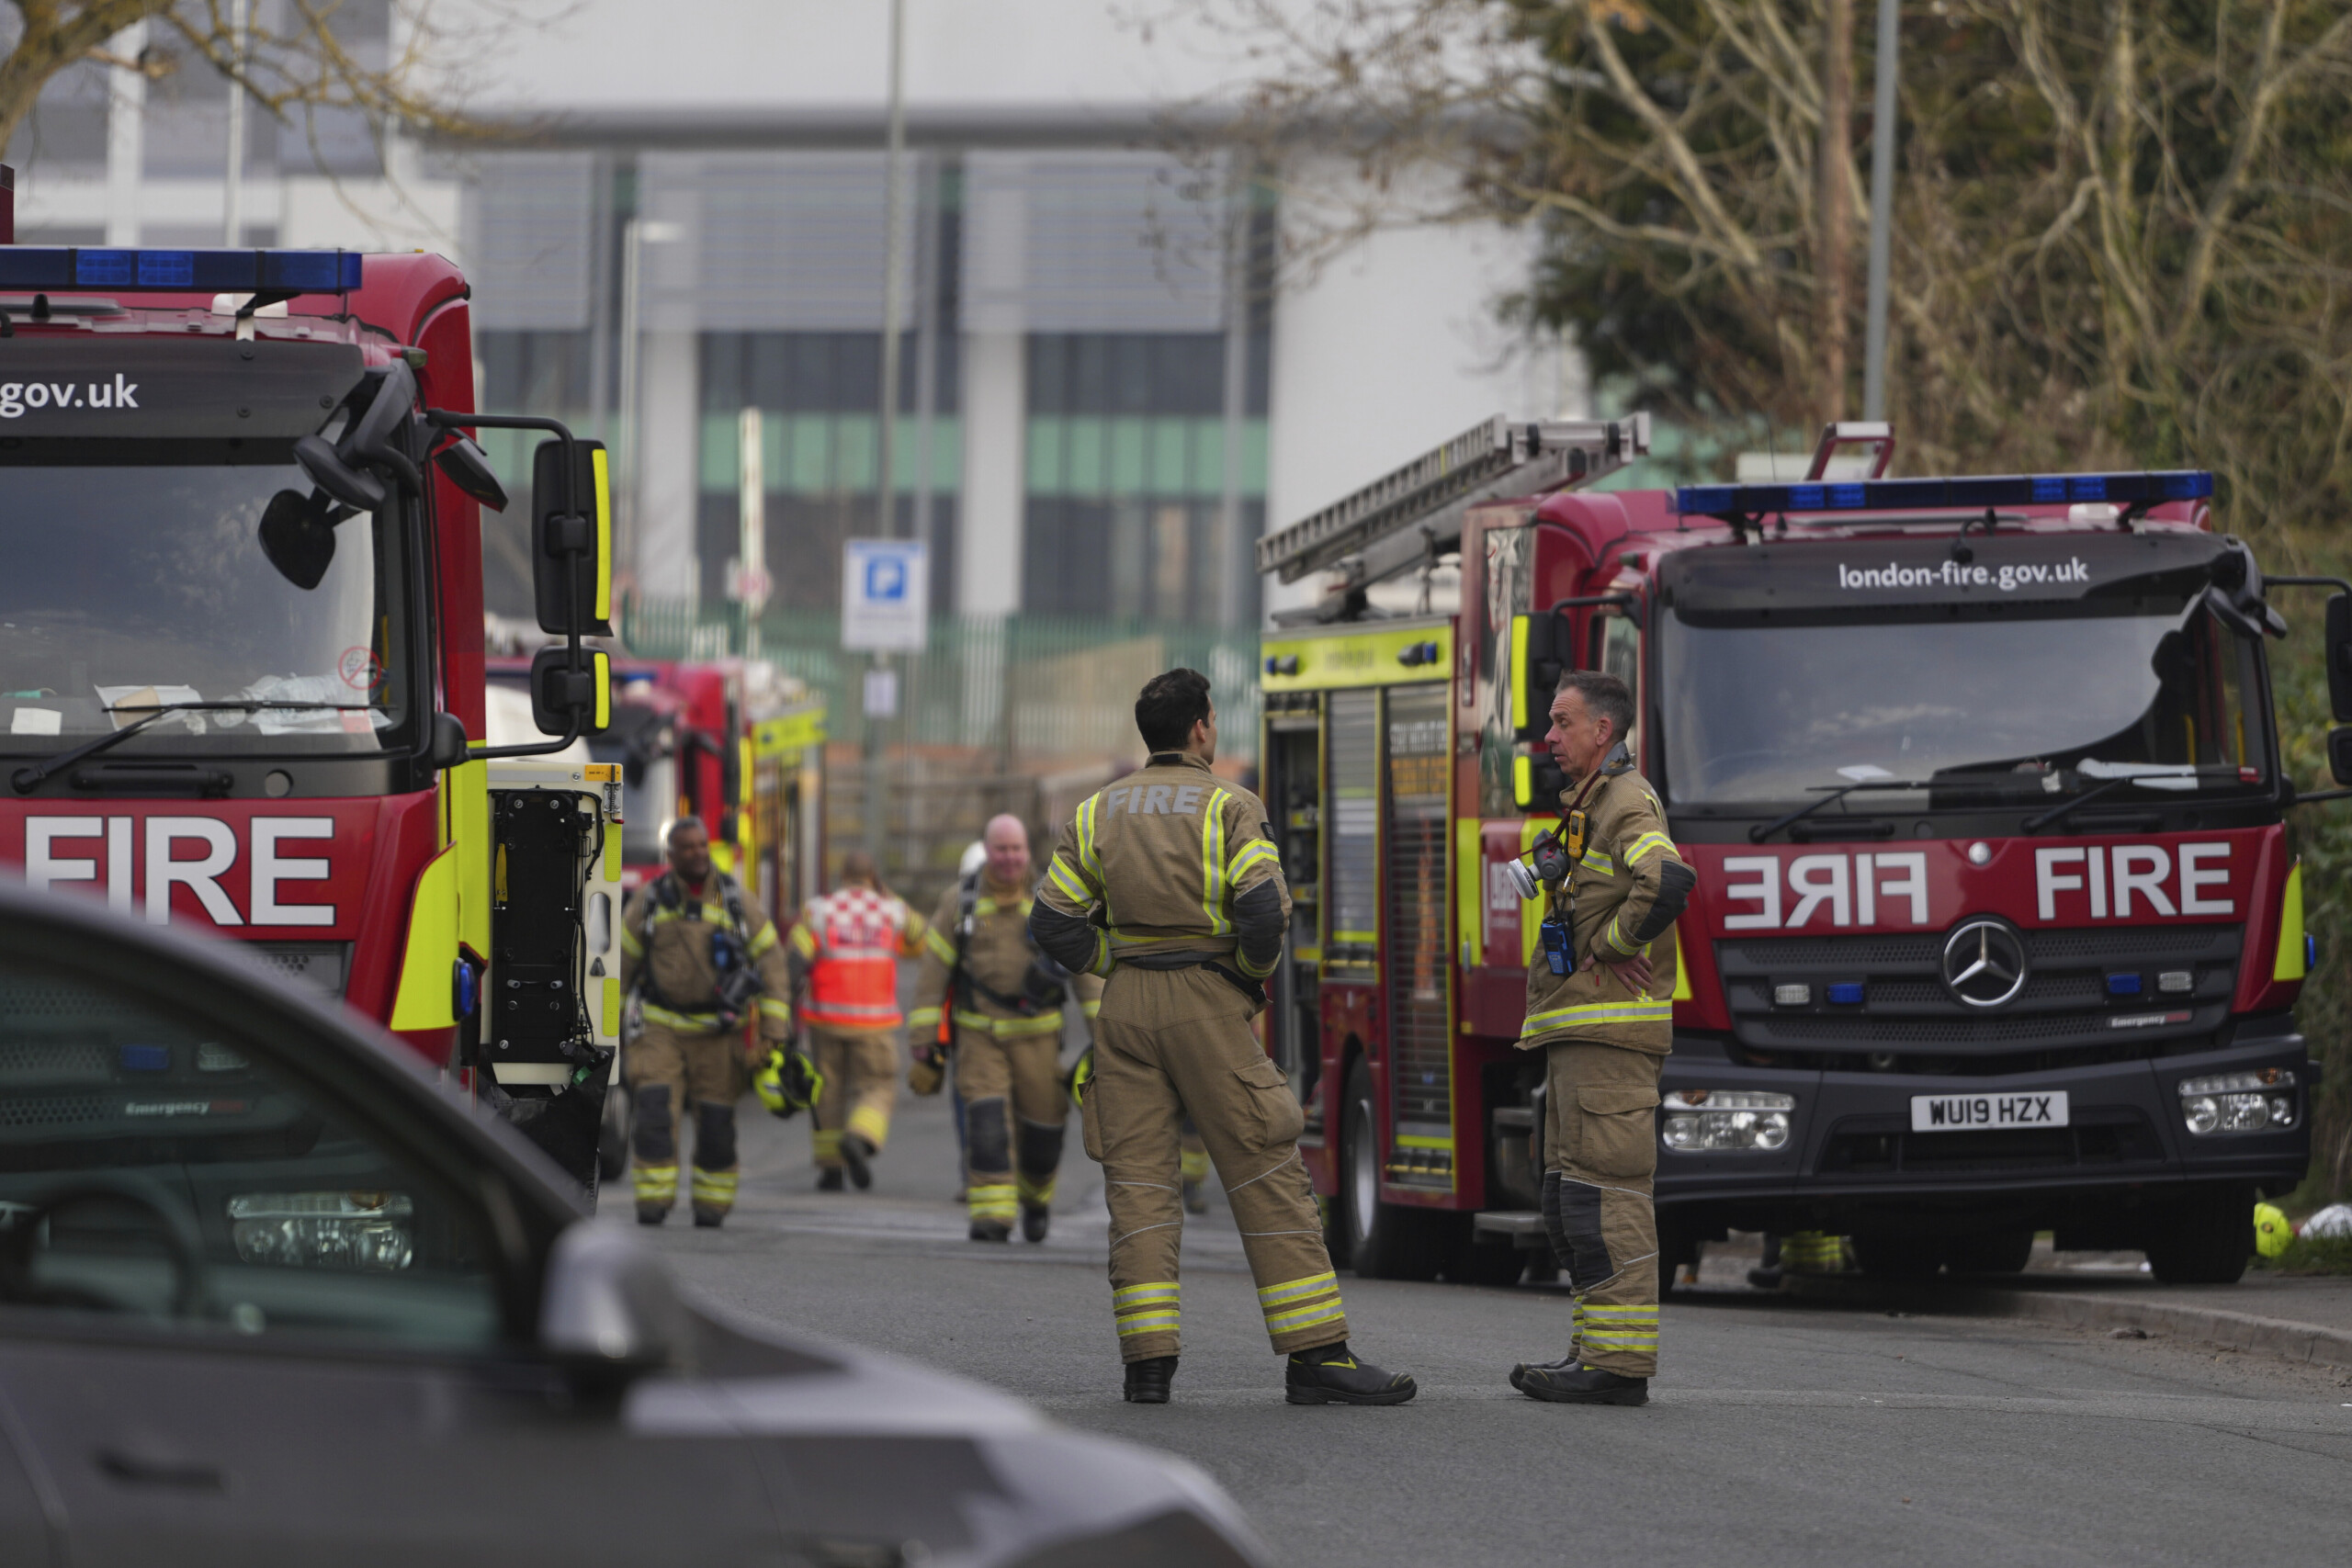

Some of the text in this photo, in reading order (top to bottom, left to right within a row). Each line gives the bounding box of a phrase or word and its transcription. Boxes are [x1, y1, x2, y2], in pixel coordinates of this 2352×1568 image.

[1838, 557, 2089, 591] london-fire.gov.uk
[1106, 784, 1203, 820] FIRE
[25, 816, 336, 926] FIRE
[2035, 841, 2234, 920] FIRE
[1930, 1096, 2052, 1125] WU19 HZX
